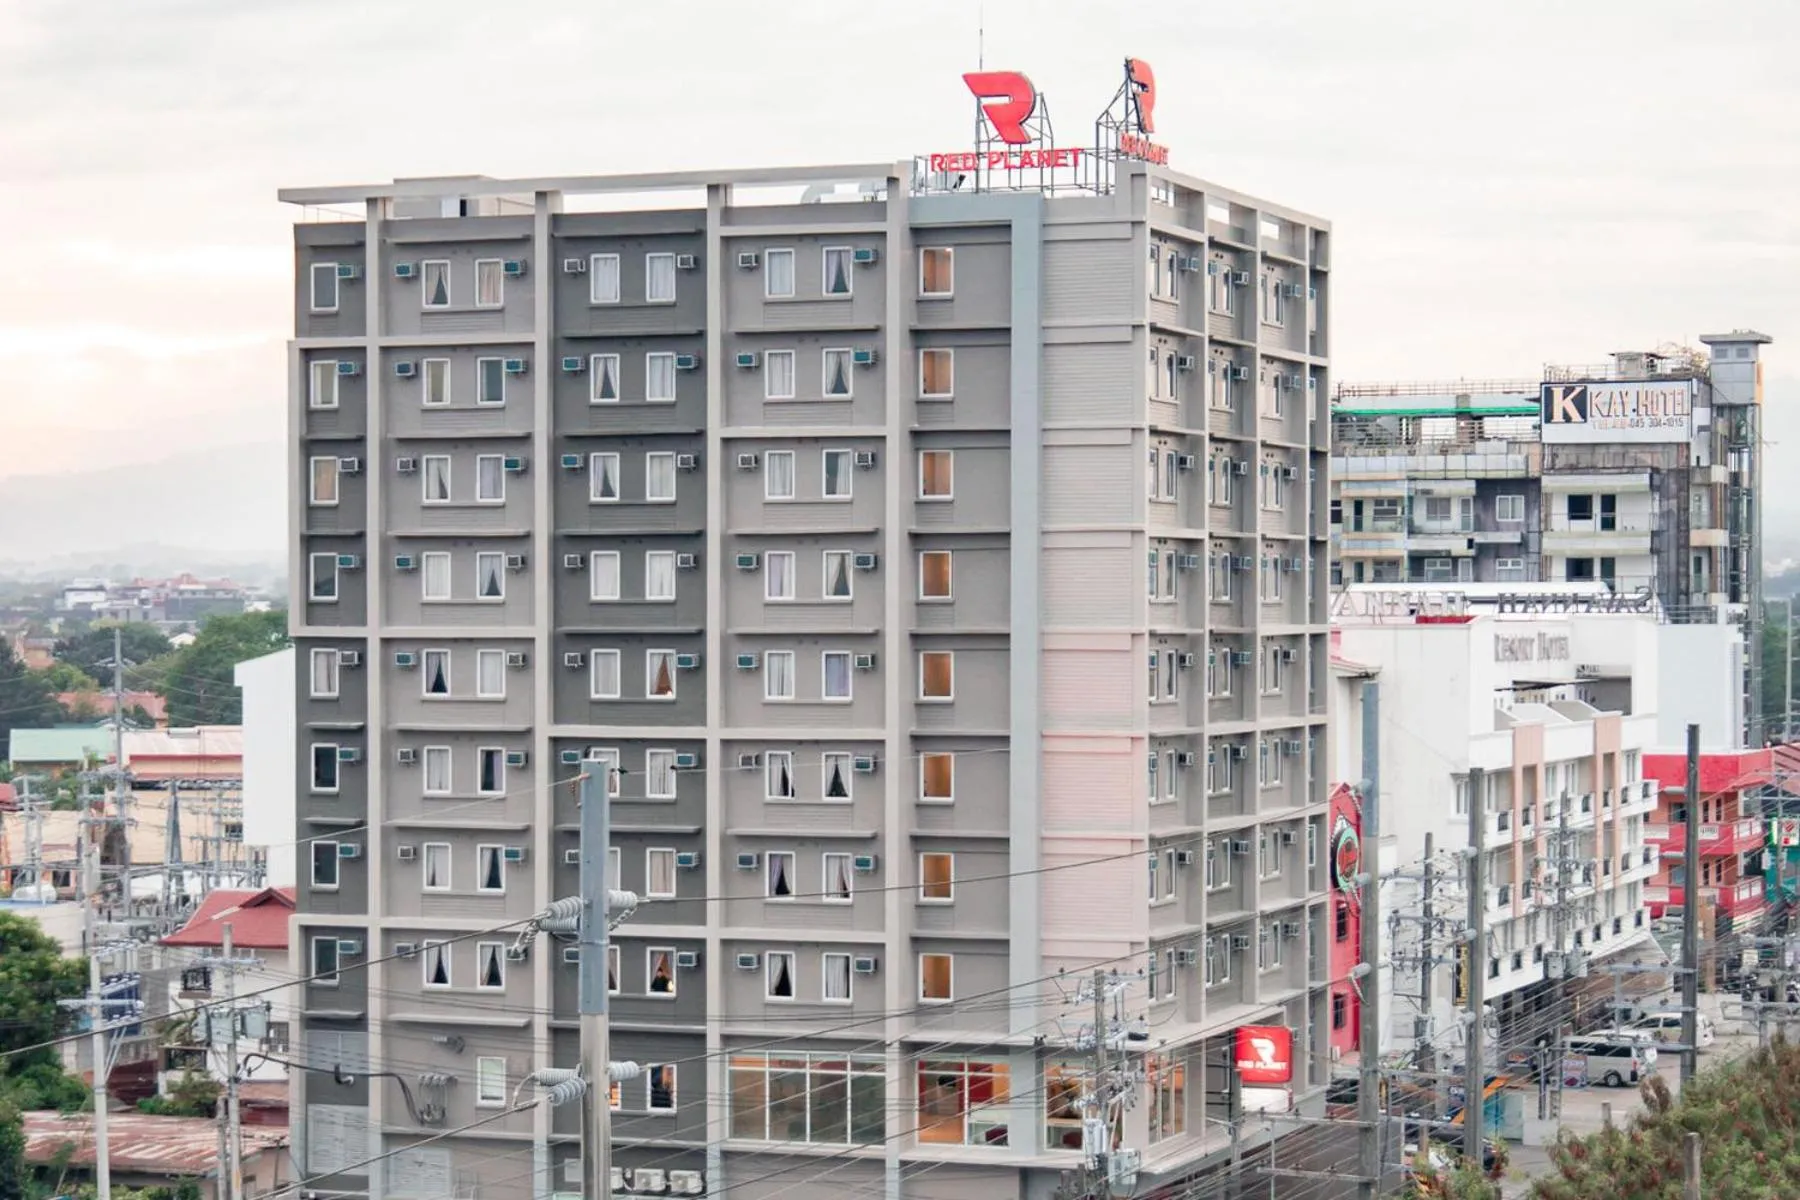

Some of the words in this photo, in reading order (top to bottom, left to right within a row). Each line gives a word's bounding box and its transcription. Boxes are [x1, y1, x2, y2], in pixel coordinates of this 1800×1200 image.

[930, 153, 978, 172] RED
[987, 148, 1085, 169] PLANET
[1550, 386, 1586, 423] K
